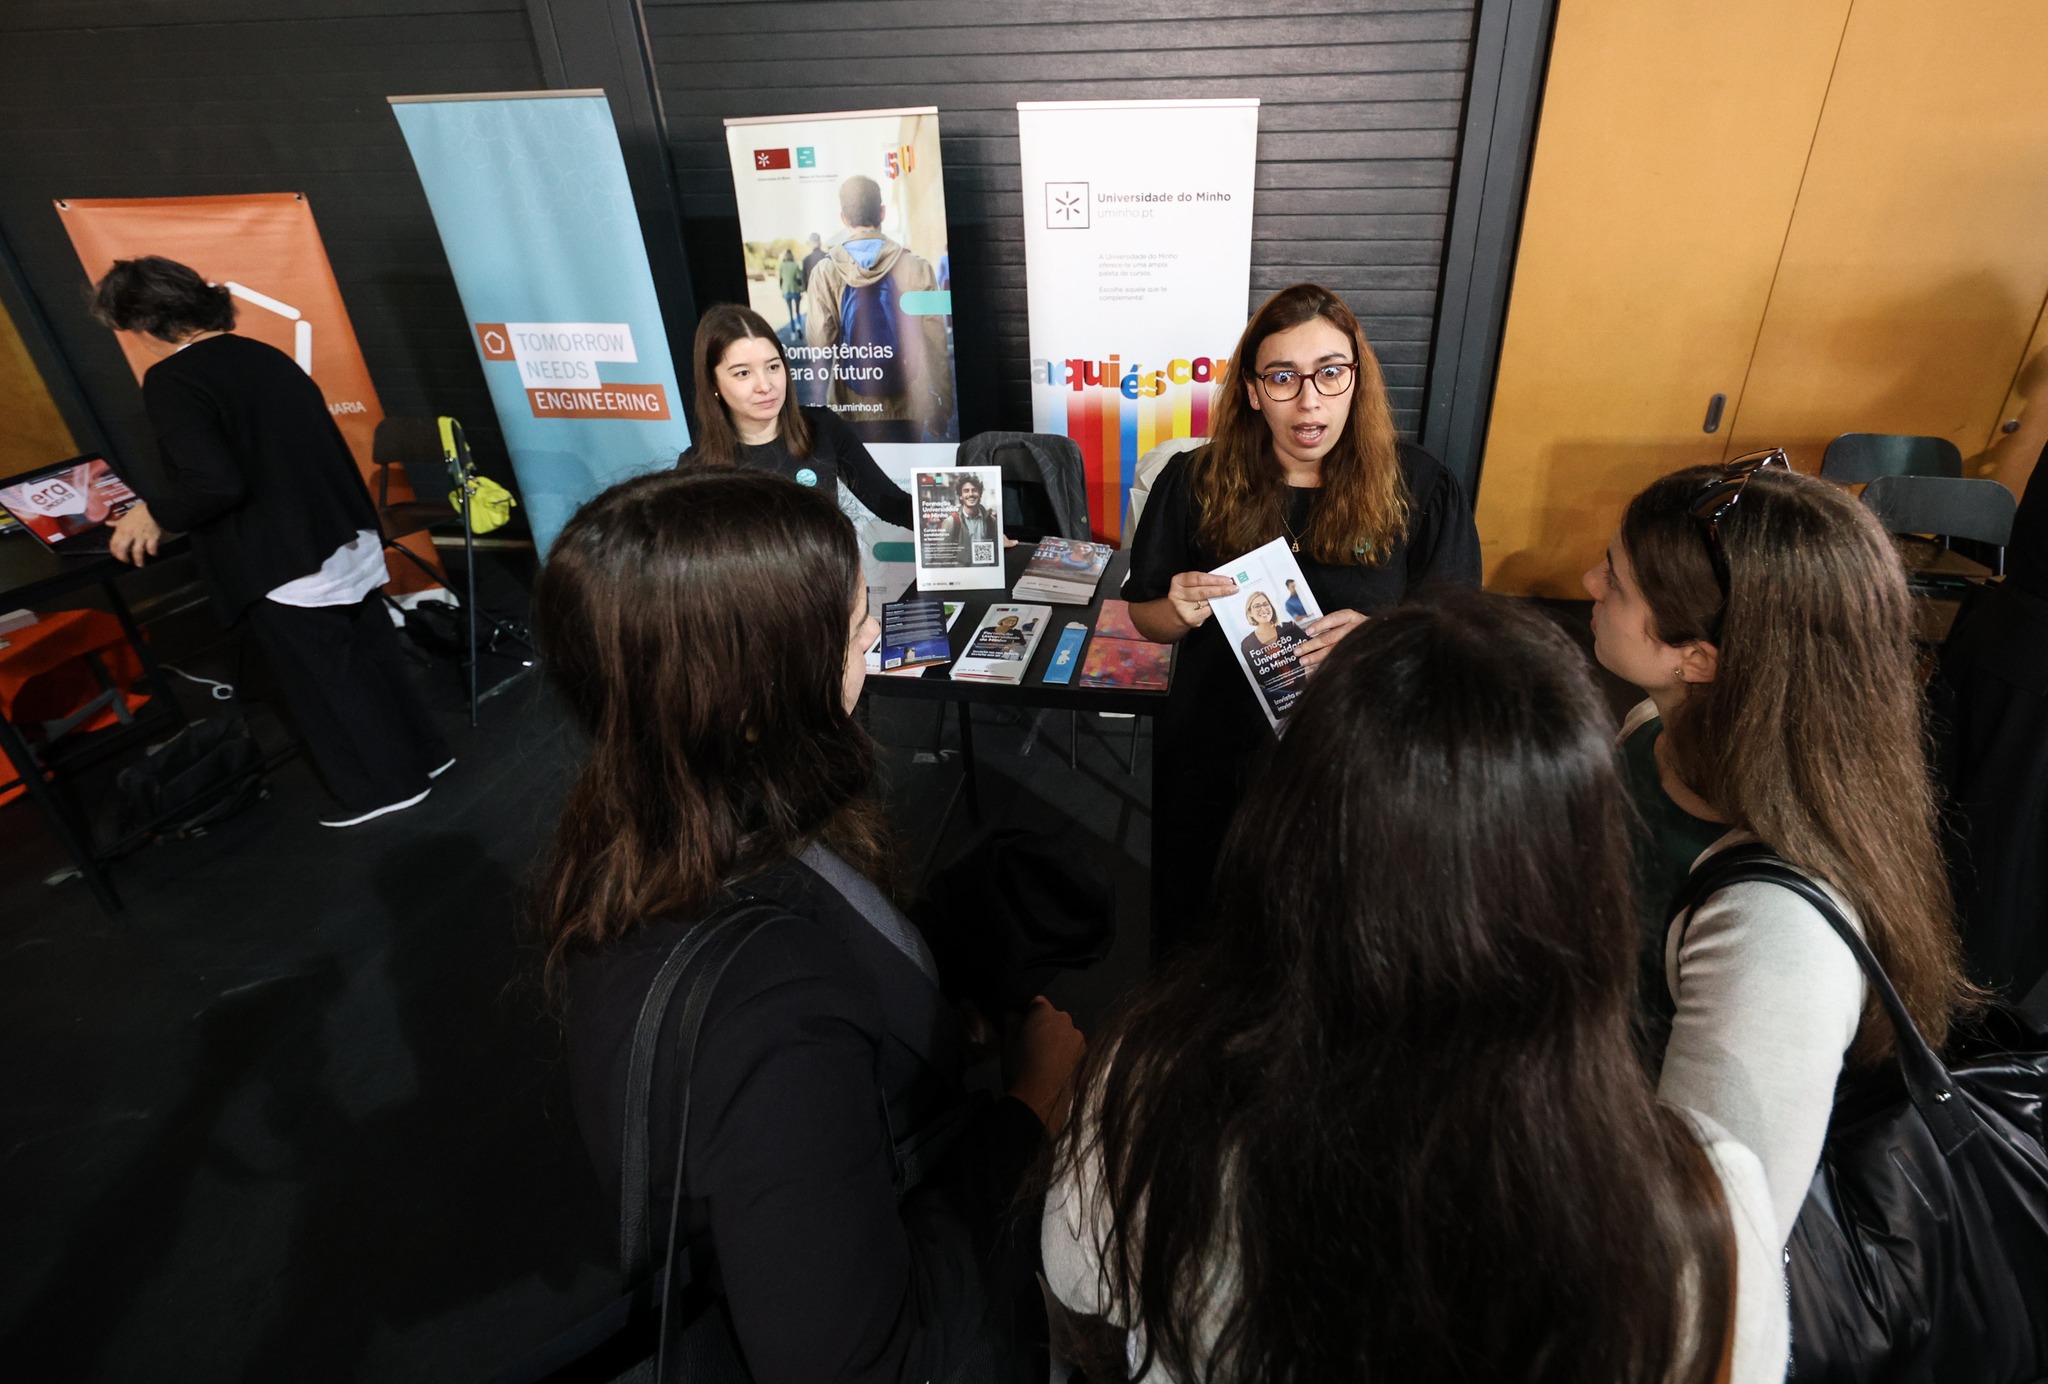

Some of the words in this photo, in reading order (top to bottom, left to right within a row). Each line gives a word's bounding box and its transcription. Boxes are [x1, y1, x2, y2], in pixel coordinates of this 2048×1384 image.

[1098, 192, 1173, 203] Universidade
[1177, 193, 1192, 202] do
[1196, 192, 1231, 202] Minho
[1098, 208, 1153, 218] uminho.pt
[517, 333, 624, 353] TOMORROW
[526, 361, 590, 379] NEEDS
[789, 368, 814, 380] ara
[818, 367, 829, 380] o
[833, 364, 884, 380] futuro
[1031, 354, 1120, 391] aqui
[534, 391, 660, 412] ENGINEERING
[30, 483, 68, 506] era
[1249, 635, 1292, 659] Formação
[1259, 665, 1270, 675] do
[1270, 655, 1297, 671] Minho
[1273, 693, 1295, 706] Invista
